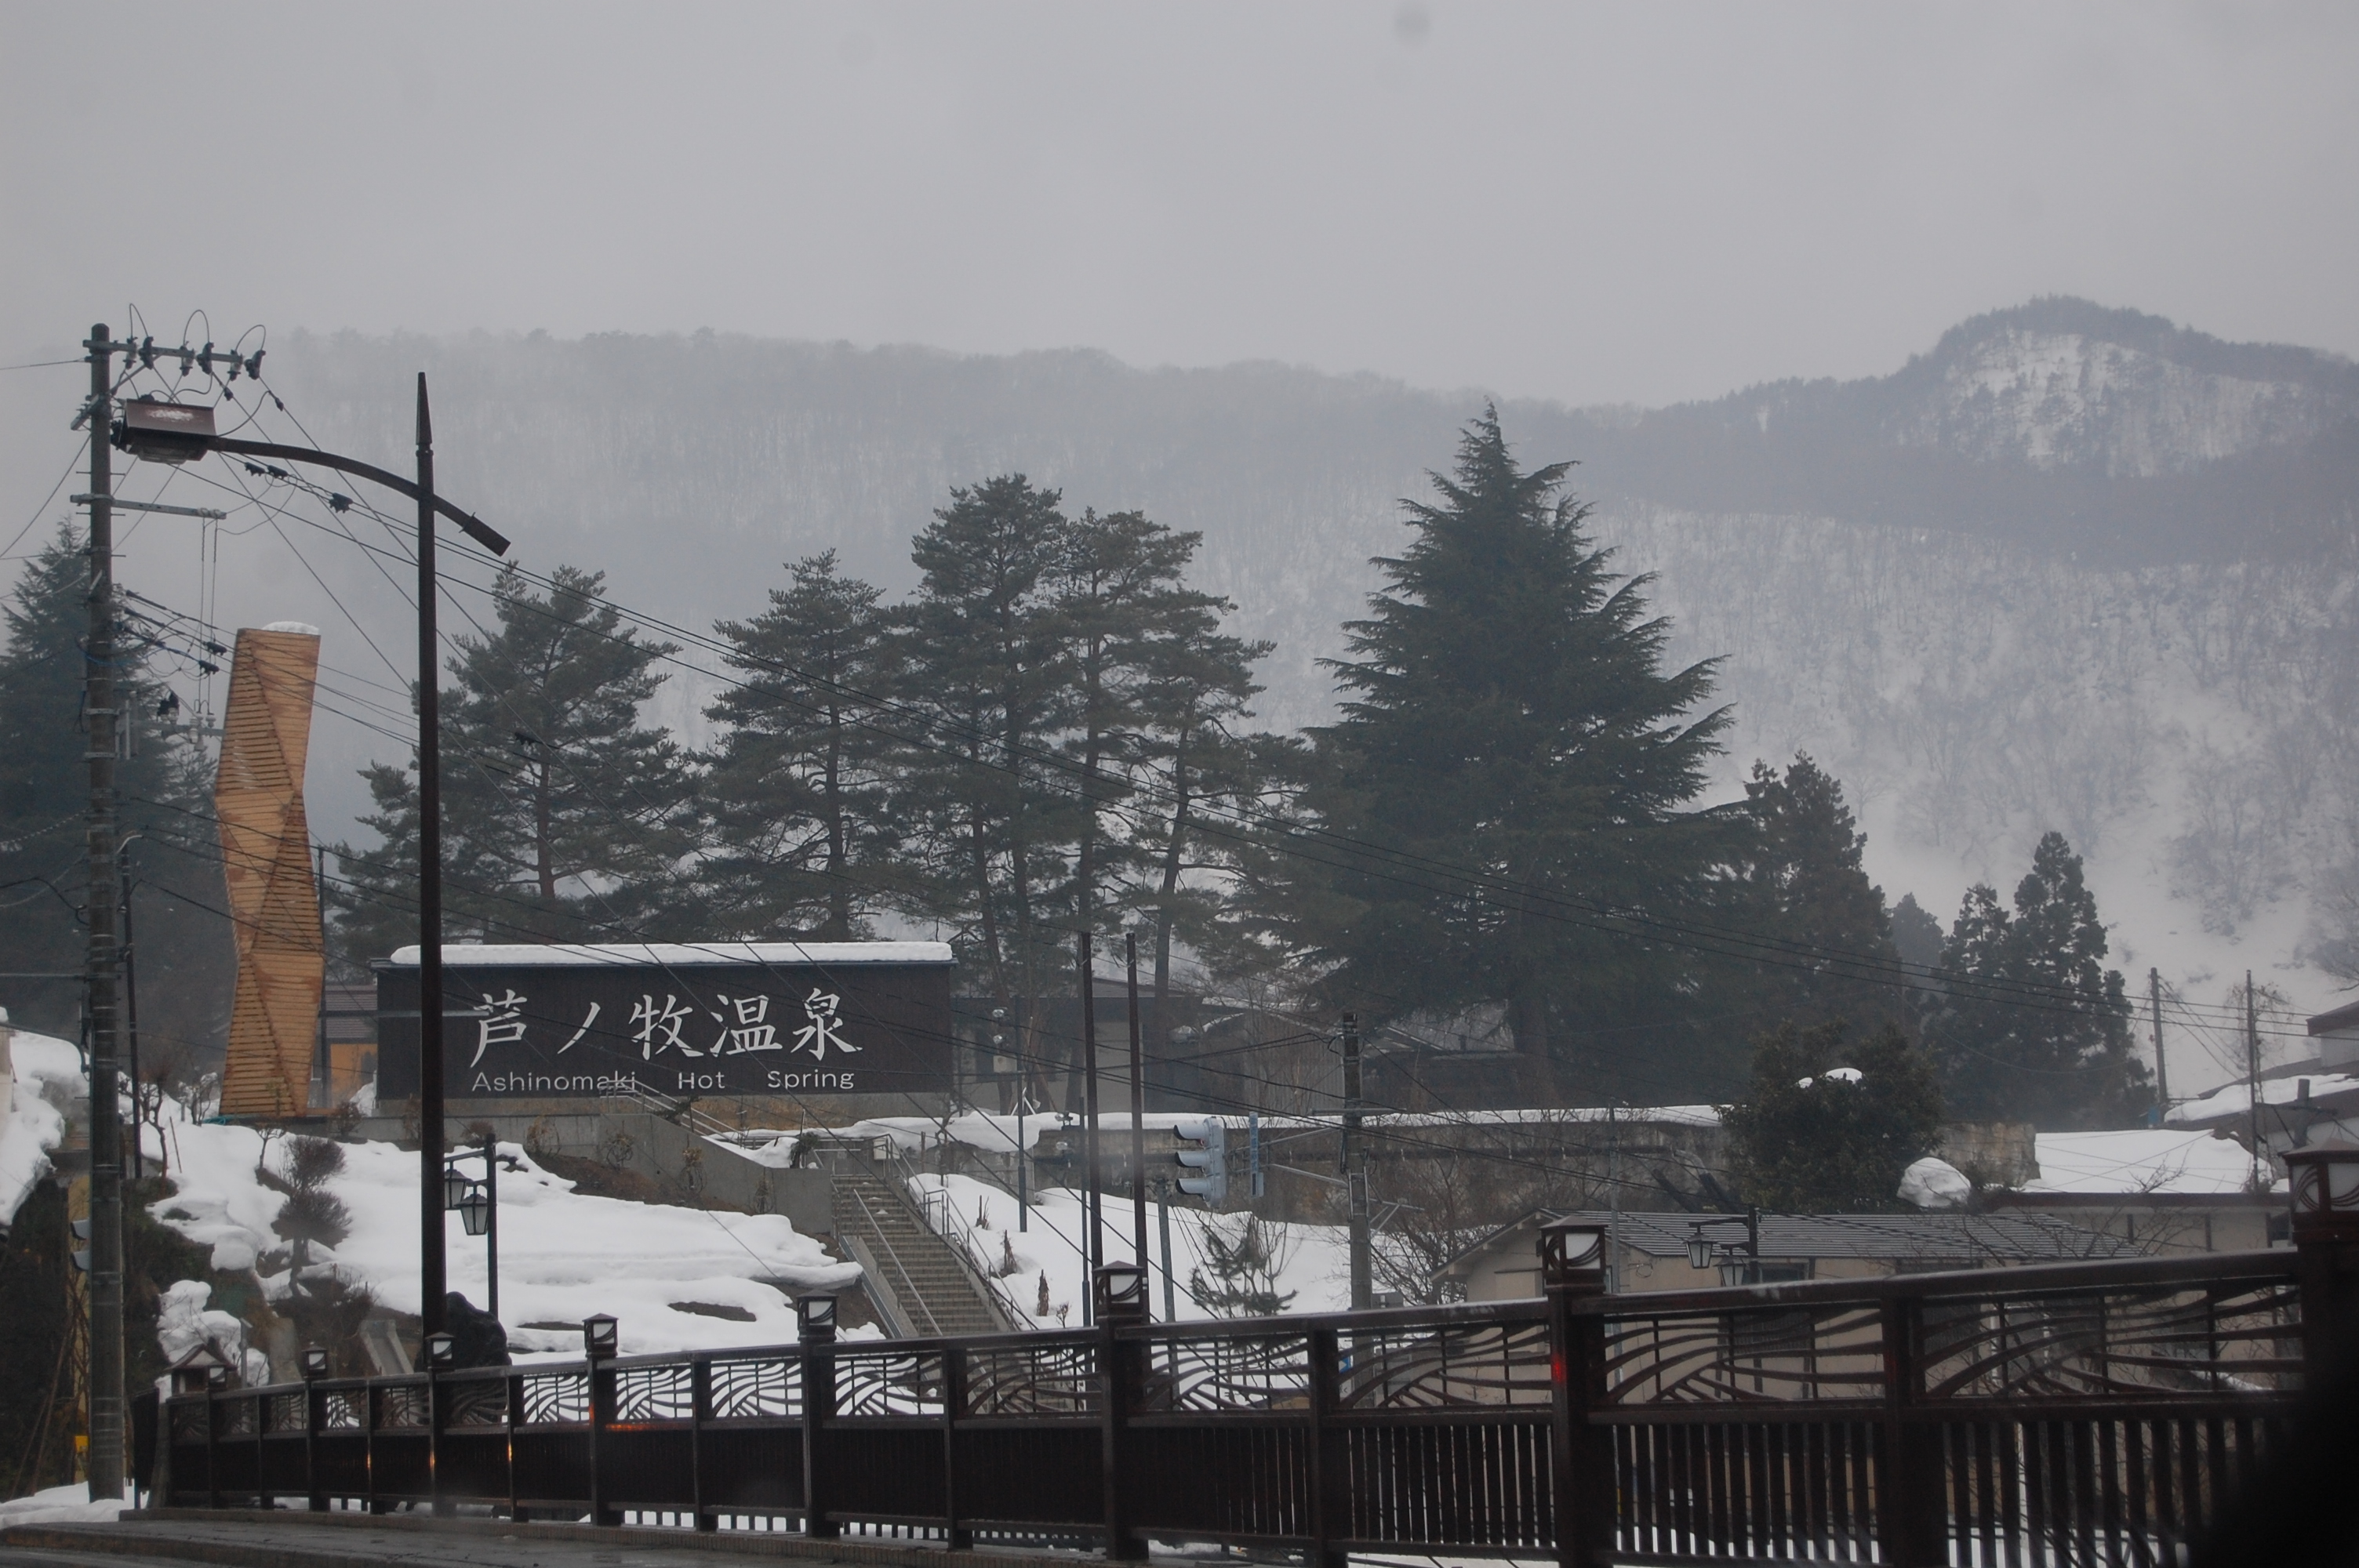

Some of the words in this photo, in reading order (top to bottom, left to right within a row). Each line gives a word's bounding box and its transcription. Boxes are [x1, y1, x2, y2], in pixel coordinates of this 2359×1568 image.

[471, 987, 863, 1067] 芦ノ牧温泉
[471, 1070, 636, 1092] Ashinomaki
[678, 1071, 725, 1090] Hot
[767, 1069, 855, 1089] Spring
